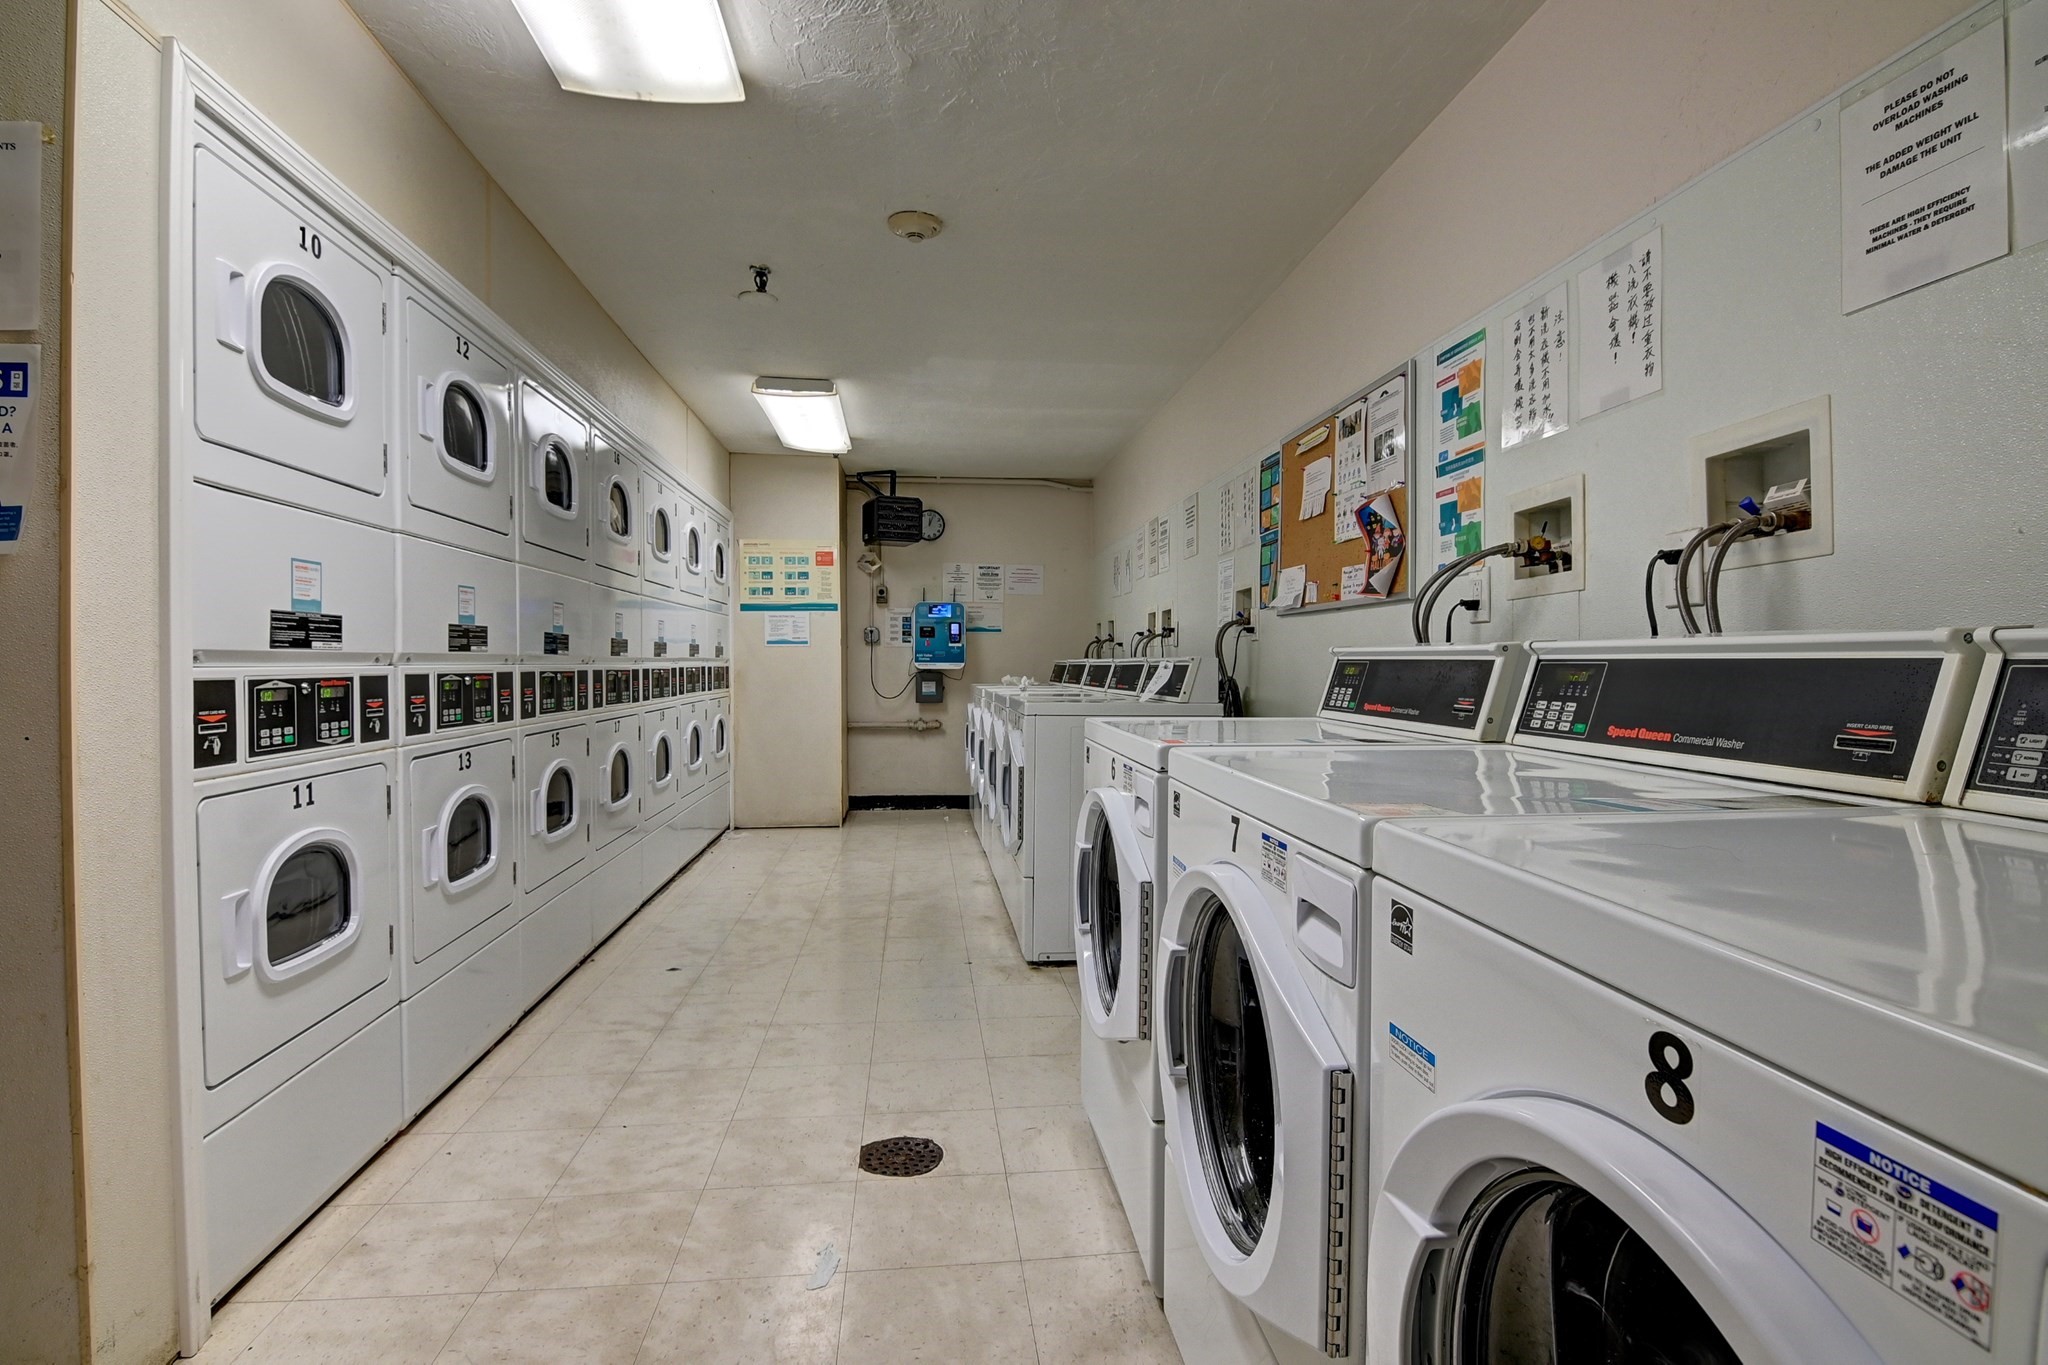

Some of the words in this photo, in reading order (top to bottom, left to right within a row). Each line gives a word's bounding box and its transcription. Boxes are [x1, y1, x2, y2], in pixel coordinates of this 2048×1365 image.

[1872, 100, 1920, 131] OVERLOAD
[1922, 74, 1968, 104] WASHING
[1884, 88, 1918, 114] PLEASE
[1920, 80, 1934, 94] DO
[1936, 68, 1955, 84] NOT
[1895, 100, 1944, 131] MACHINES
[1865, 160, 1881, 174] THE
[1883, 144, 1914, 166] ADDED
[1916, 124, 1952, 148] WEIGHT
[1954, 112, 1979, 129] WILL
[1880, 154, 1918, 179] DAMAGE
[1920, 144, 1938, 159] THE
[1940, 132, 1962, 149] UNIT
[1869, 222, 1890, 235] THESE
[1891, 214, 1906, 226] ARE
[1907, 206, 1925, 219] HIGH
[1927, 185, 1971, 210] EFFICIENCY
[1872, 223, 1908, 243] MACHINES
[1913, 212, 1932, 225] THEY
[1933, 197, 1968, 217] REQUIRE
[299, 226, 321, 259] 10
[1866, 238, 1896, 255] MINIMAL
[1897, 226, 1922, 241] WATER
[1931, 203, 1975, 228] DETERGENT
[456, 336, 469, 360] 12
[2, 422, 12, 433] A
[614, 452, 620, 465] 16
[551, 732, 560, 748] 15
[615, 720, 620, 733] 17
[1607, 725, 1638, 738] Speed
[1638, 728, 1672, 741] Queen
[1672, 733, 1714, 746] Commercial
[1716, 737, 1745, 749] Washer
[458, 752, 472, 771] 13
[1112, 757, 1116, 780] 6
[293, 782, 314, 809] 11
[1231, 815, 1240, 853] 7
[1395, 1028, 1429, 1060] NOTICE
[1645, 1031, 1696, 1125] 8
[1817, 1176, 1832, 1189] NON
[1869, 1150, 1931, 1195] NOTICE
[1819, 1156, 1876, 1194] RECOMMENDED
[1880, 1189, 1894, 1204] FOR
[1898, 1200, 1917, 1217] BEST
[1921, 1212, 1988, 1257] PERFORMANCE
[1824, 1146, 1841, 1163] HIGH
[1844, 1157, 1889, 1189] EFFICIENCY
[1920, 1198, 1971, 1233] DETERGENT
[1974, 1227, 1983, 1239] IS
